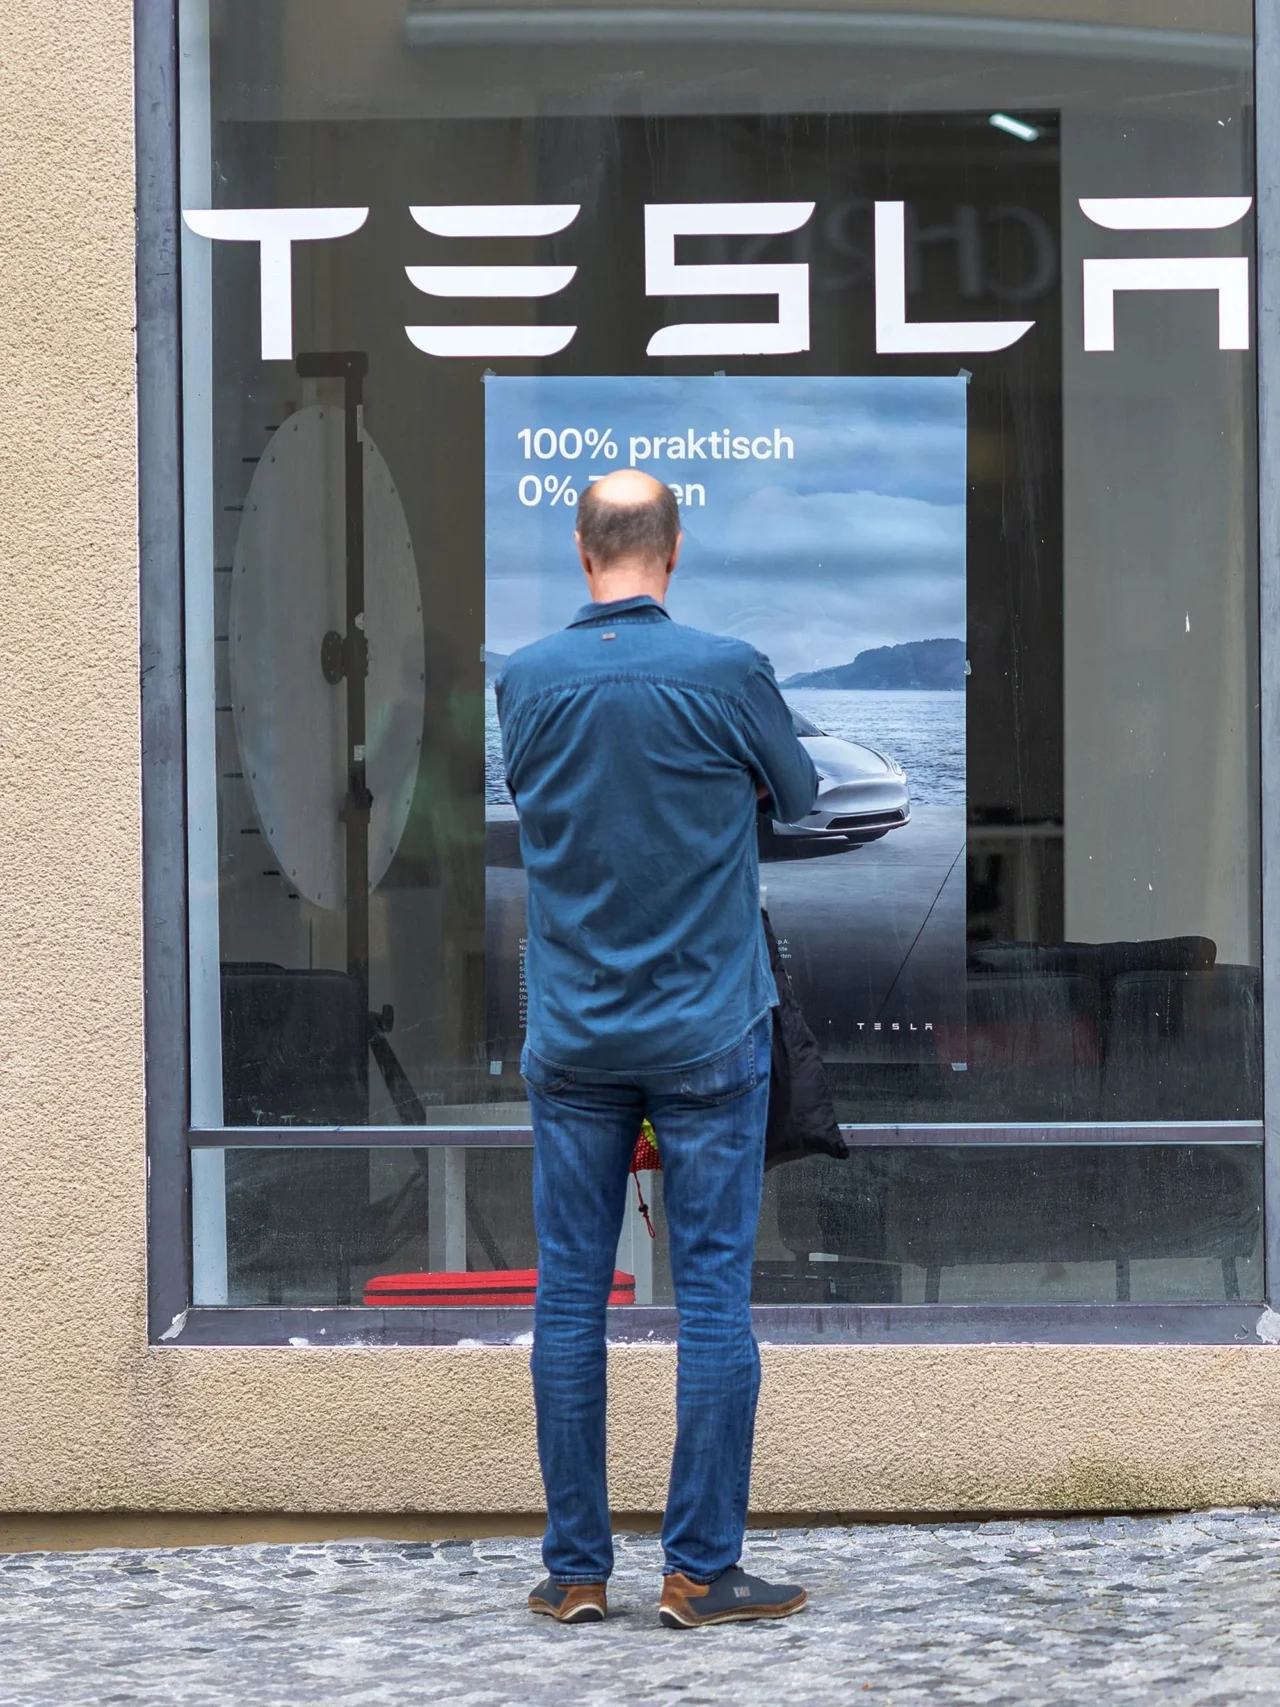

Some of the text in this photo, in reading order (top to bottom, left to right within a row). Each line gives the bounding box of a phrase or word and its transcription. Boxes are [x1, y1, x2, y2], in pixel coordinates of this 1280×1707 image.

[182, 197, 1252, 361] TESLA
[517, 428, 794, 467] 100% praktisch
[518, 475, 578, 506] 0%
[856, 1022, 933, 1031] TESLA
